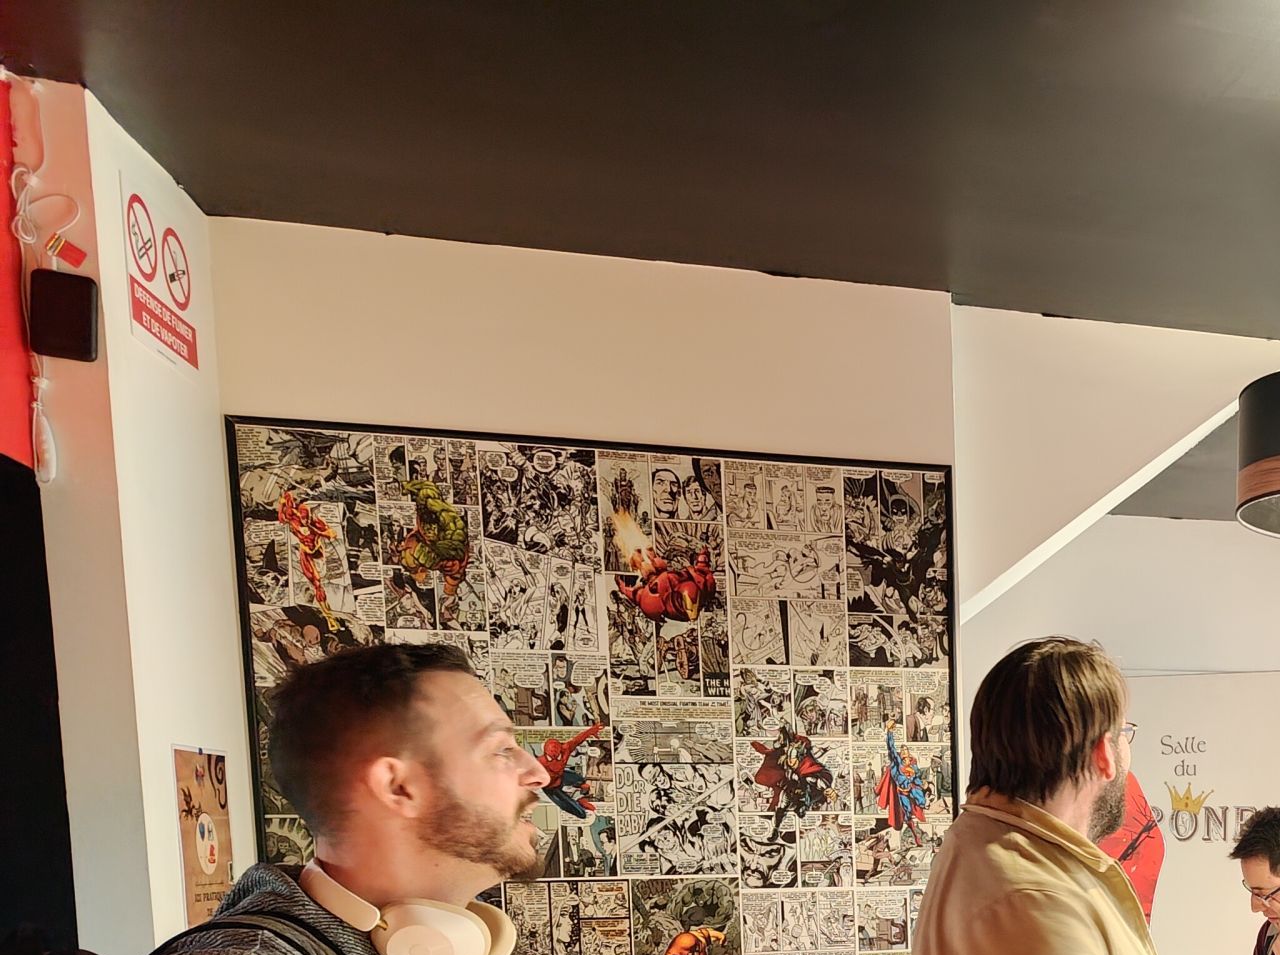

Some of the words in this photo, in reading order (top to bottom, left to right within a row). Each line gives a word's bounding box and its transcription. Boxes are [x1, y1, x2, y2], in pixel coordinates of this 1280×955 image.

[141, 311, 151, 329] ET
[151, 317, 161, 337] DE
[160, 324, 189, 359] VAPOTER
[162, 307, 172, 326] DE
[171, 314, 194, 343] FUMER
[705, 678, 721, 687] THE
[1160, 734, 1208, 756] Salle
[615, 766, 634, 790] DO
[1173, 759, 1198, 777] du
[633, 779, 646, 794] OR
[618, 808, 650, 837] BABY!
